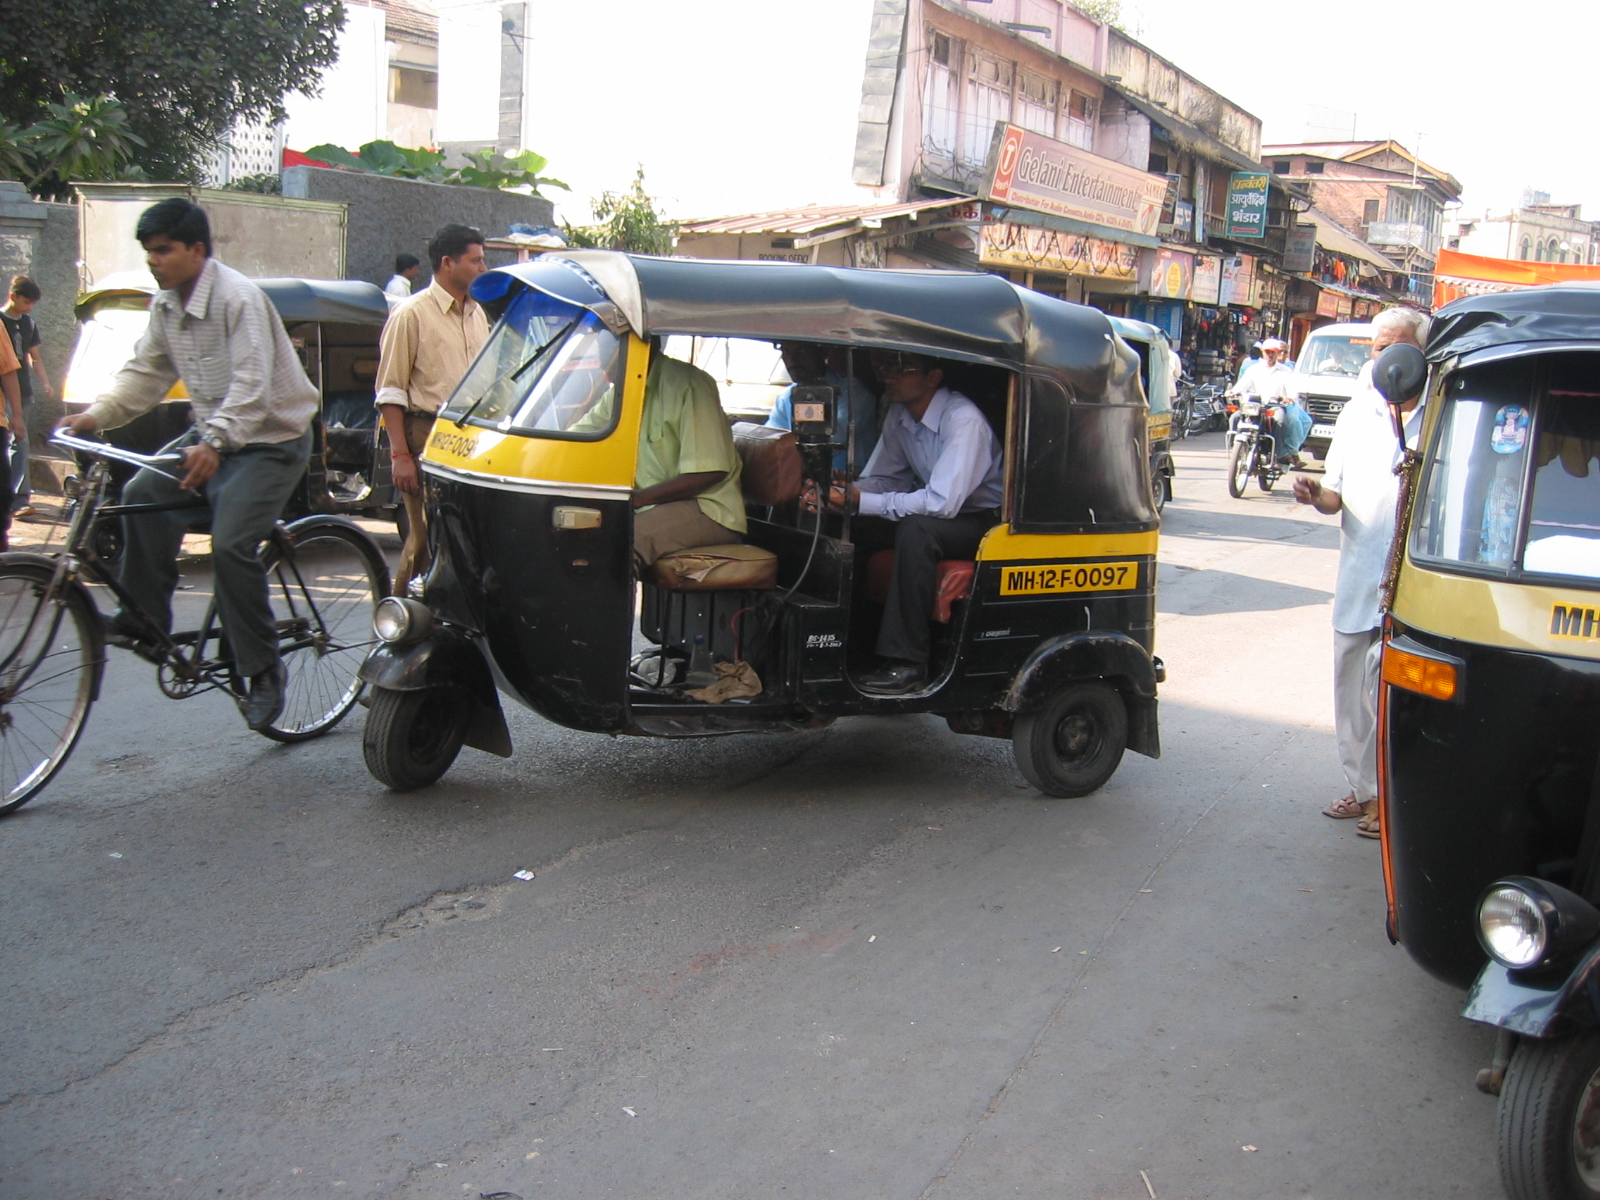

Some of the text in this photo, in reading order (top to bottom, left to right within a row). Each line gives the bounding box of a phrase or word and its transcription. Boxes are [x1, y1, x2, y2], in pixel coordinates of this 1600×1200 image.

[1018, 147, 1137, 210] Gelani Entertainment
[1232, 209, 1260, 223] भंडार
